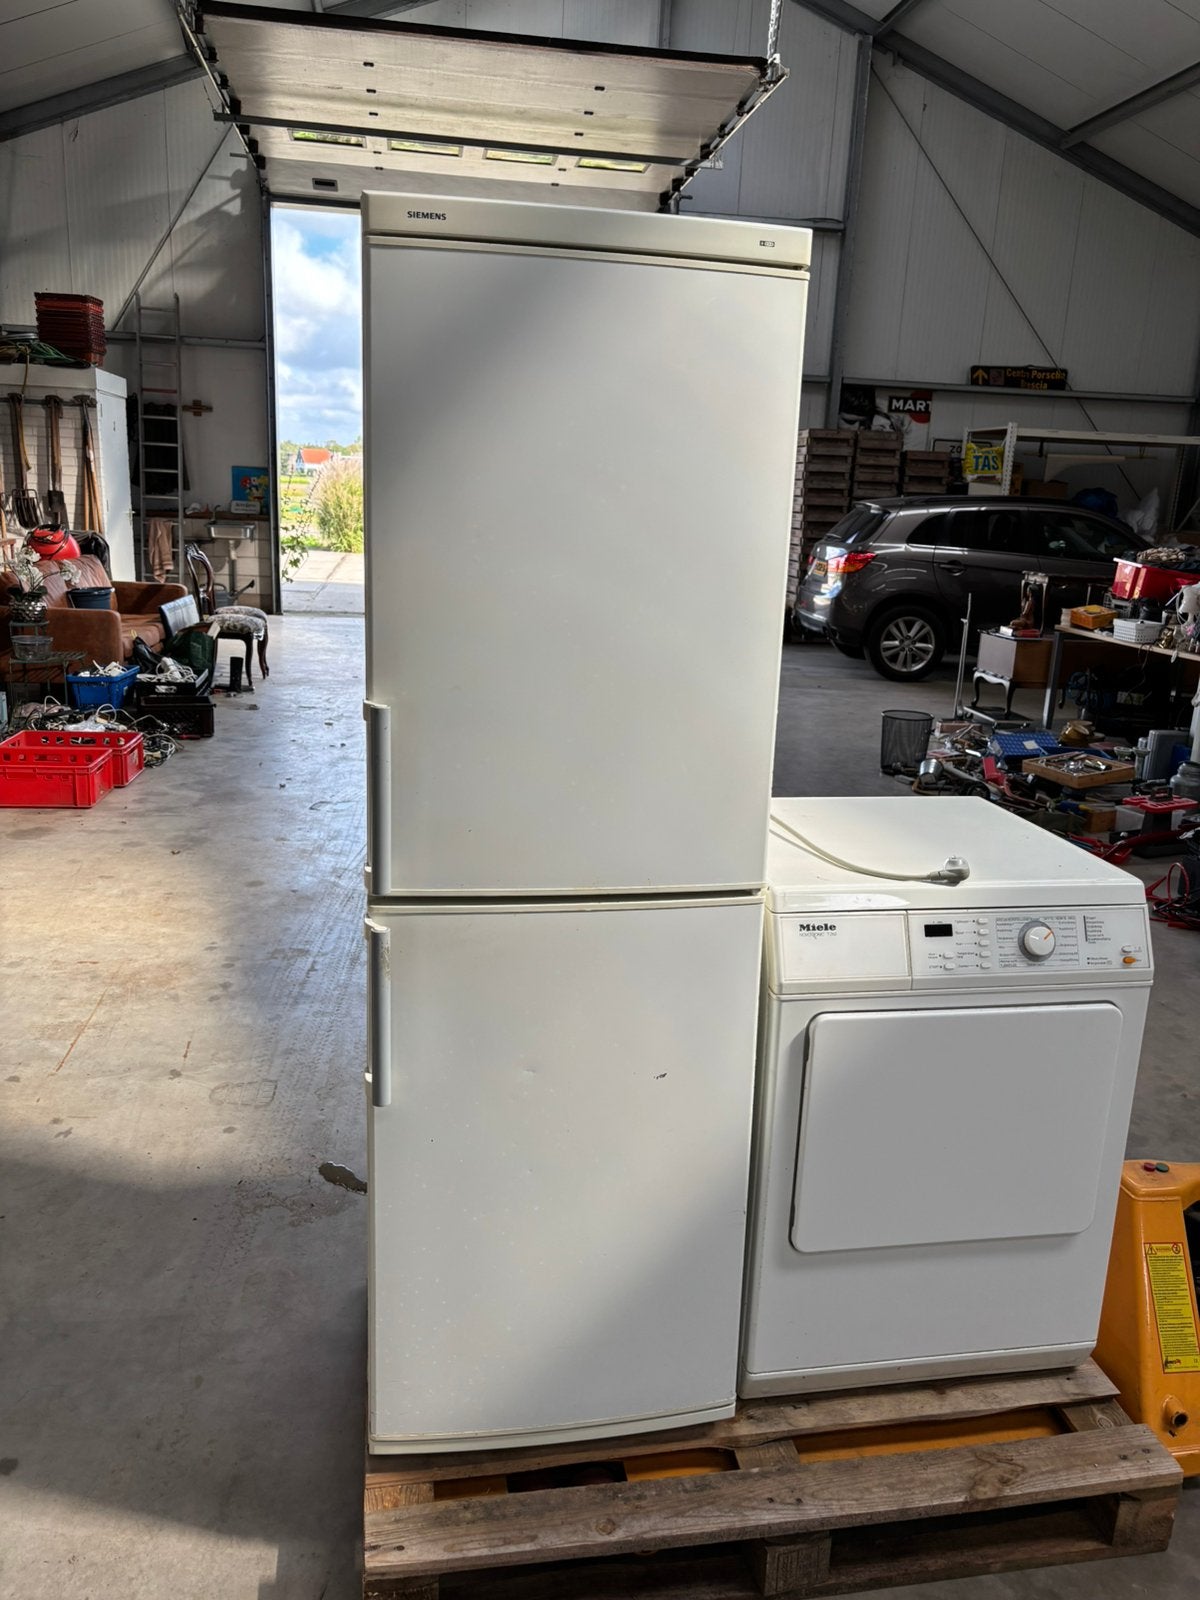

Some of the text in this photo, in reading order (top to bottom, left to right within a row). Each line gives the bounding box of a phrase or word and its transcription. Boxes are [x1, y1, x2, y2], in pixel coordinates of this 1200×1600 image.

[407, 210, 447, 221] SIEMENS
[973, 455, 999, 471] TAS
[799, 923, 837, 932] Miele
